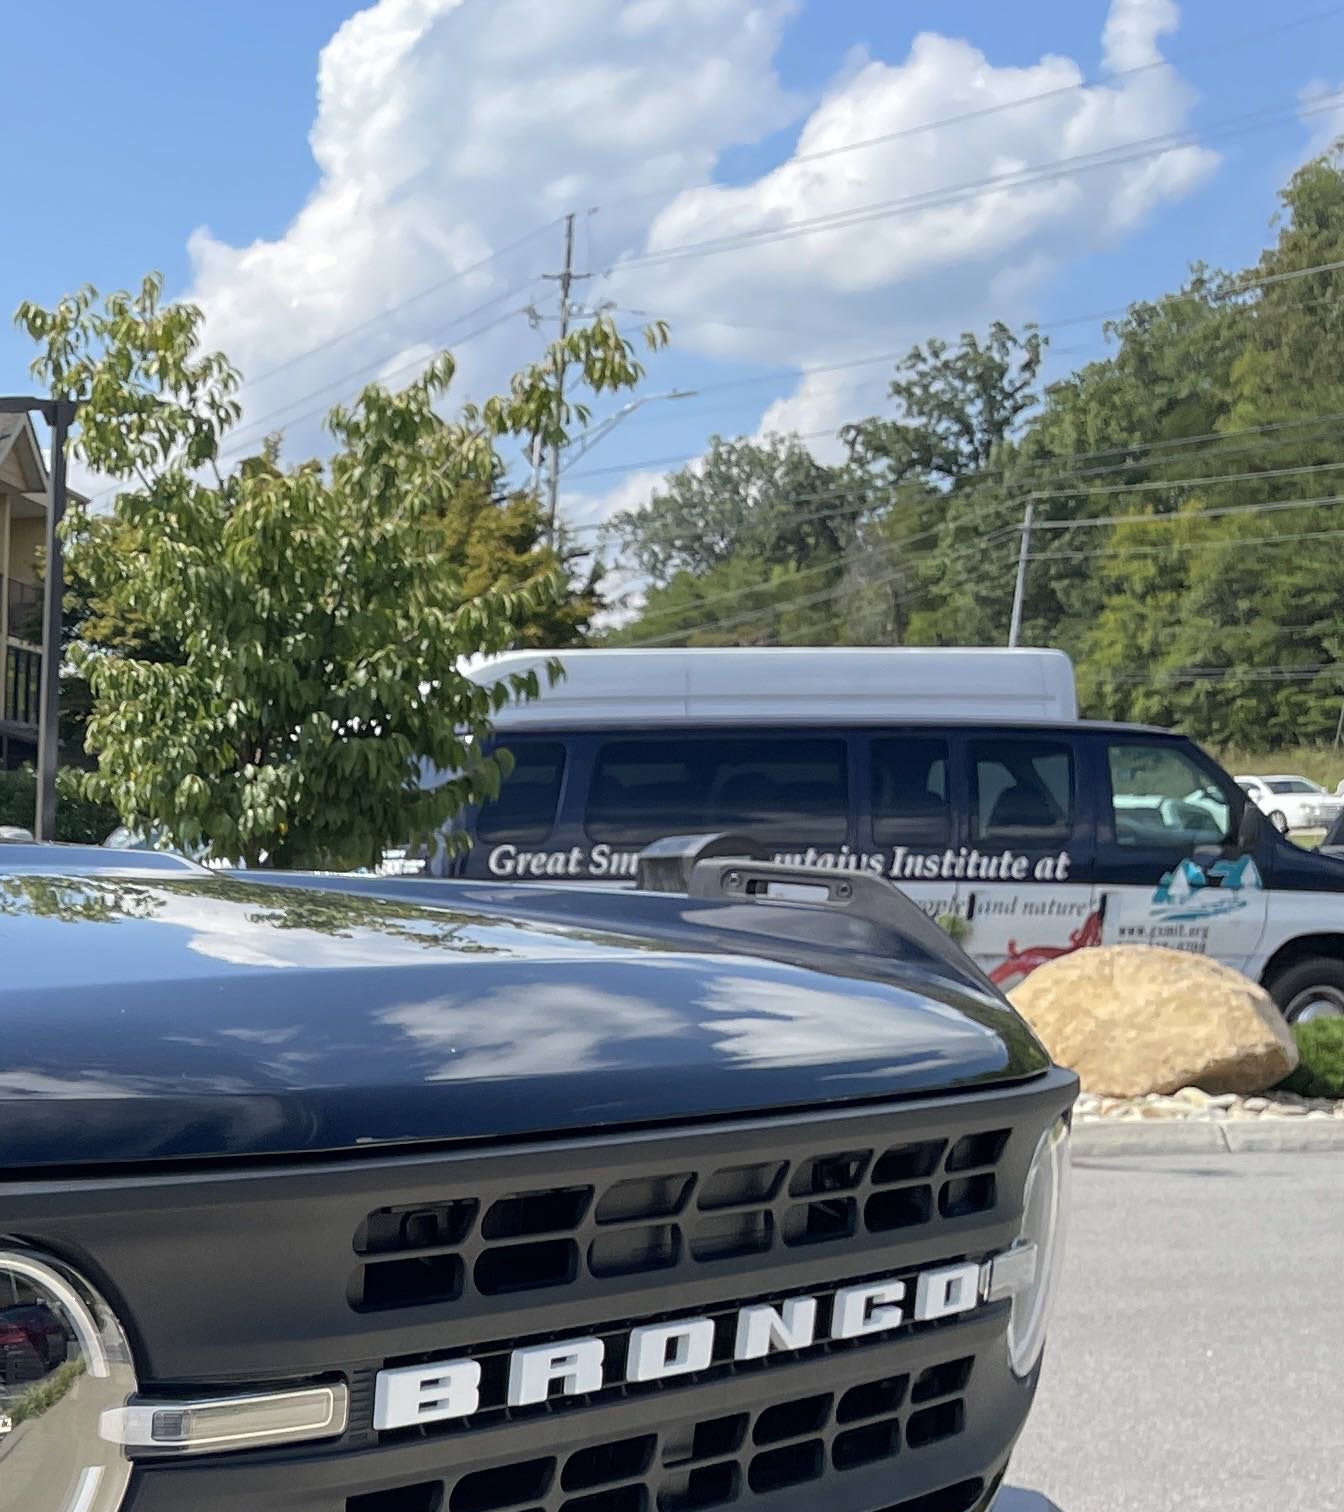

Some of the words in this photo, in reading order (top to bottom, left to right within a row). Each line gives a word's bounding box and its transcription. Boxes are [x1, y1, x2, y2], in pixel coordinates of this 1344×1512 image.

[487, 844, 582, 877] Great
[889, 846, 1029, 881] Institute
[1034, 850, 1071, 881] at
[977, 895, 1018, 916] and
[373, 1261, 981, 1432] BRONCO
